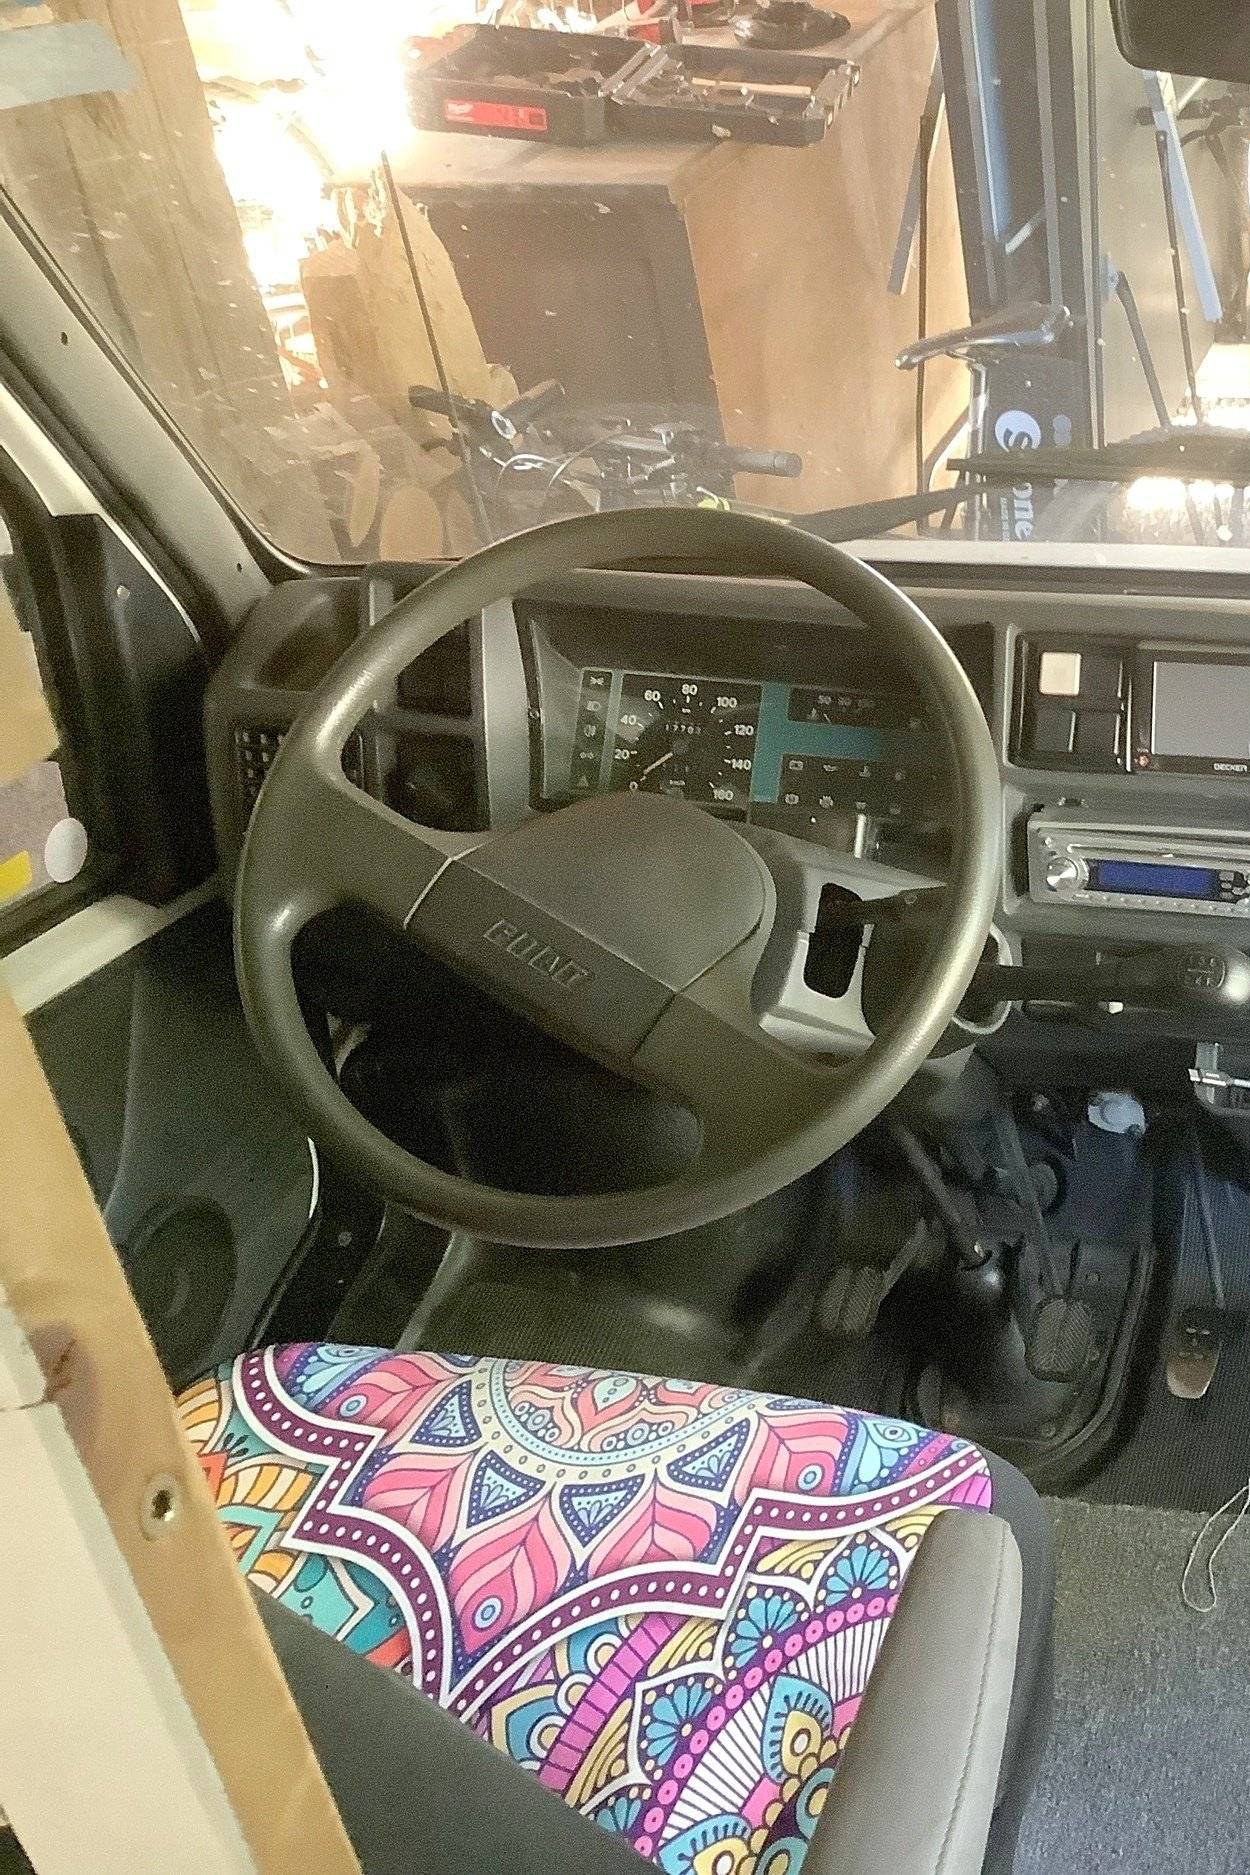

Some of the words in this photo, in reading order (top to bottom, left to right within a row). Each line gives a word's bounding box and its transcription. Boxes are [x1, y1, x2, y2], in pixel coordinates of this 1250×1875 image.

[682, 683, 698, 696] 80
[644, 690, 661, 702] 60
[717, 696, 737, 708] 100
[620, 714, 637, 726] 40
[734, 724, 754, 736] 120
[614, 748, 630, 760] 20
[731, 758, 752, 771] 140
[629, 781, 638, 792] 0
[482, 918, 590, 991] FIAT
